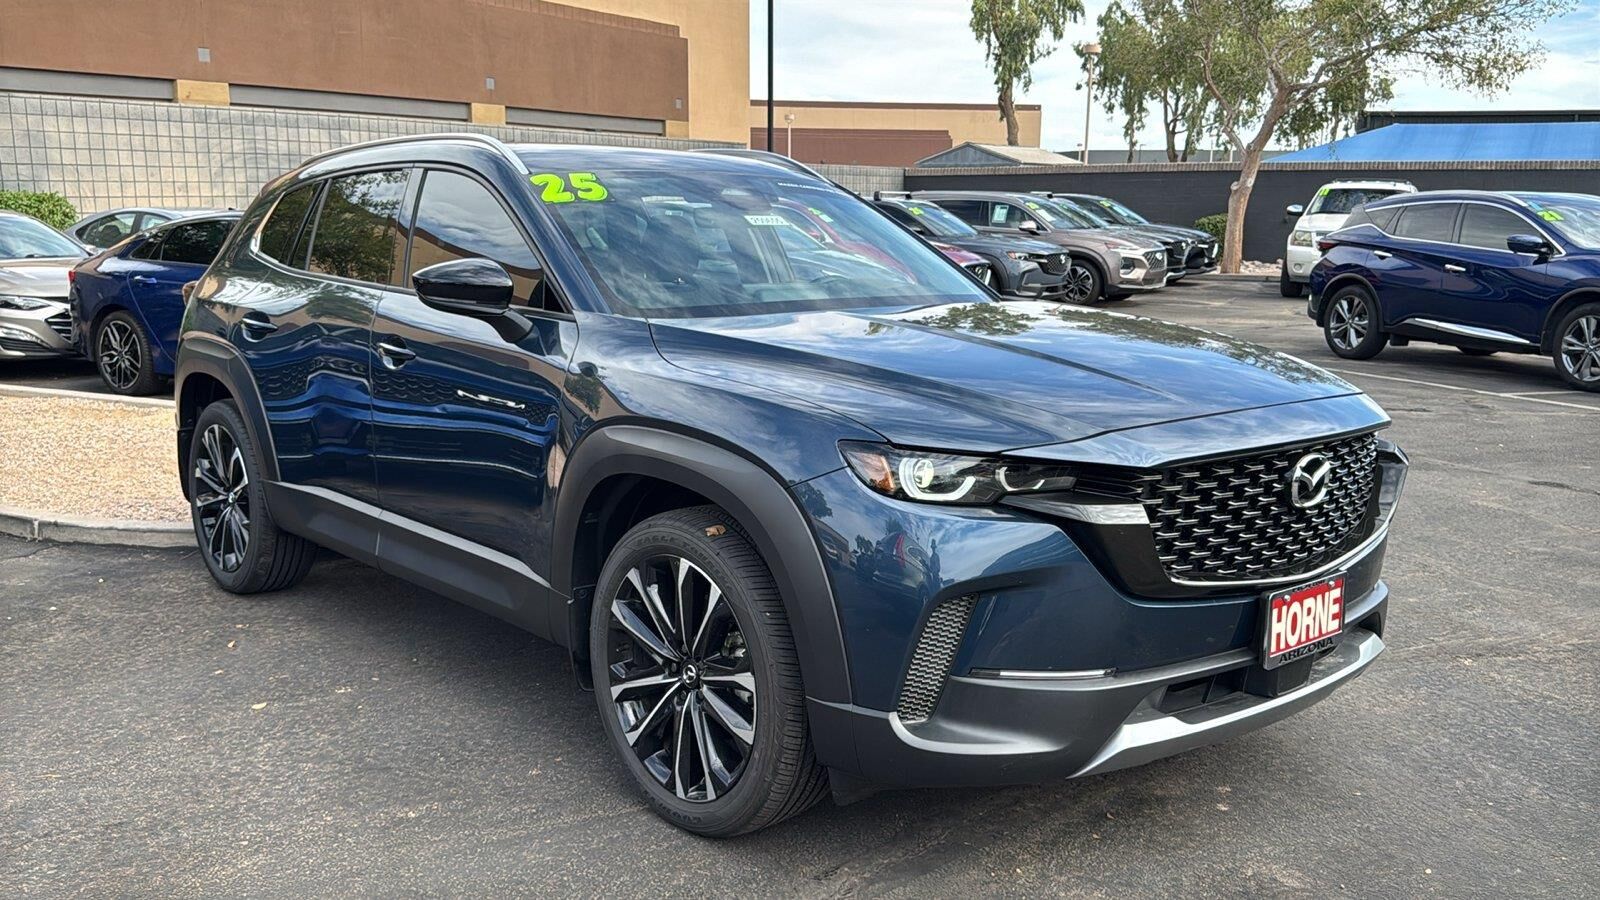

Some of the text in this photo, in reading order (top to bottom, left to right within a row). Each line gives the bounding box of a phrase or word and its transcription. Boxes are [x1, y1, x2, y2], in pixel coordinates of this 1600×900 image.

[530, 172, 608, 203] 25
[1270, 587, 1341, 653] HORNE
[1279, 637, 1334, 663] ARIZONA
